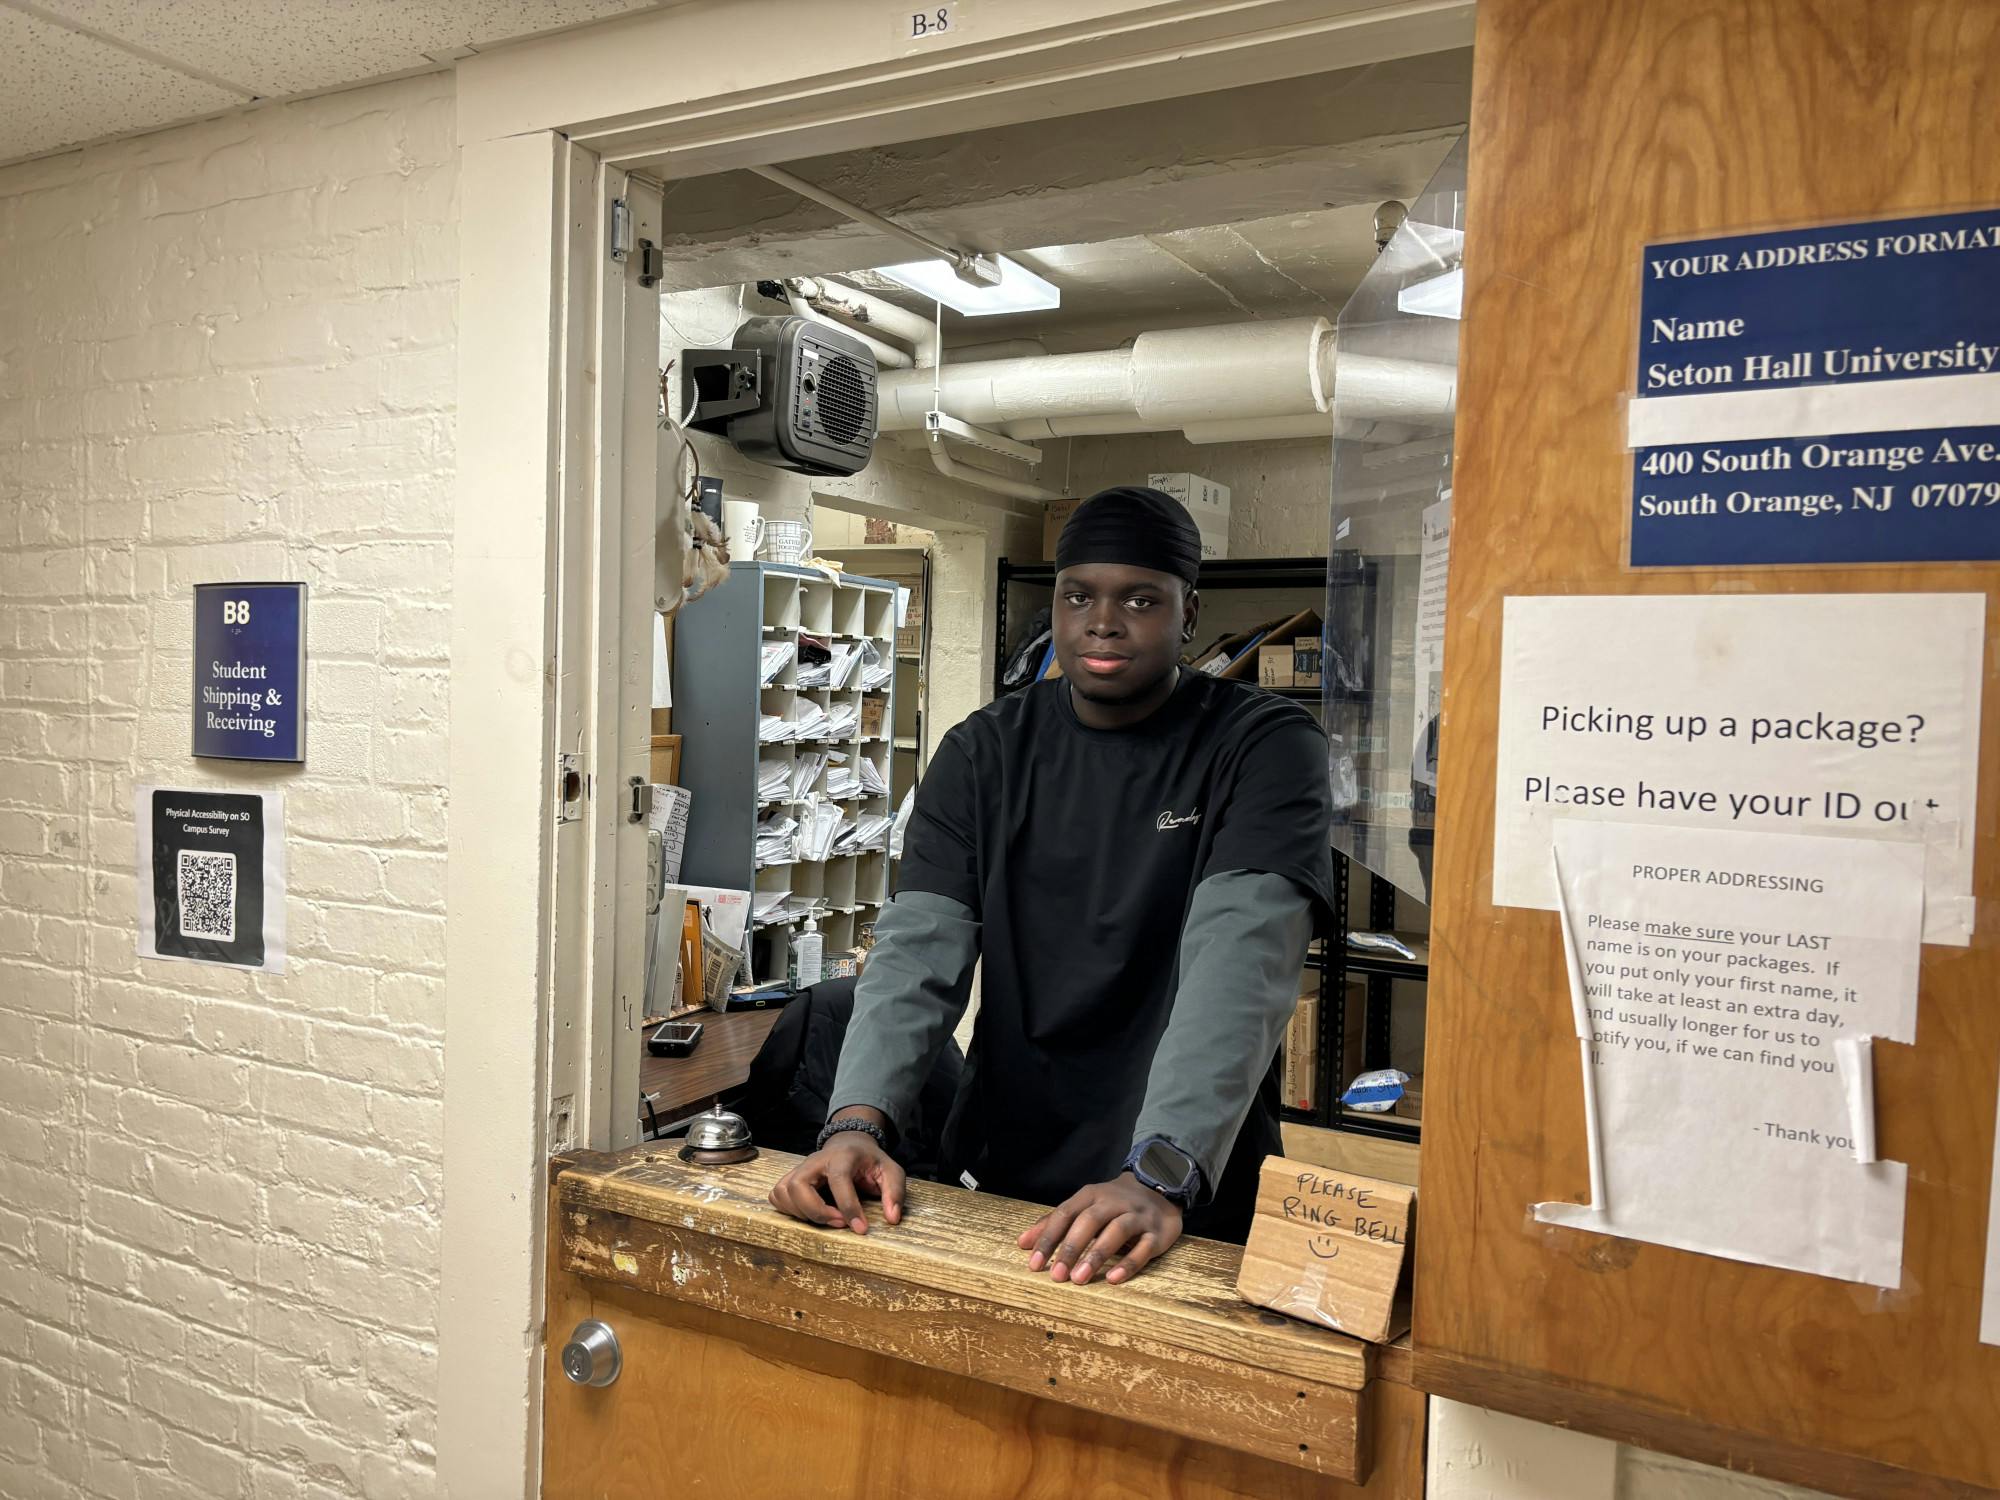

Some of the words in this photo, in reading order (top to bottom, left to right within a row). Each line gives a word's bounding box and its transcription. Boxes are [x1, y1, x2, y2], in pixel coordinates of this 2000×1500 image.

[912, 8, 948, 36] B-8
[1651, 254, 1730, 279] YOUR
[1734, 239, 1869, 271] ADDRESS
[1651, 316, 1745, 344] Name
[1647, 362, 1733, 389] Seton
[1743, 353, 1812, 381] Hall
[1823, 340, 2000, 376] University
[1641, 450, 1694, 475] 400
[1701, 446, 1792, 474] South
[1802, 442, 1925, 472] Orange
[1931, 437, 2000, 464] Ave.
[1639, 493, 1718, 517] South
[1726, 490, 1844, 517] Orange,
[1851, 485, 1896, 511] NJ
[1912, 481, 2000, 508] 07079
[224, 600, 250, 625] B8
[212, 660, 267, 679] Student
[203, 686, 262, 711] Shipping
[265, 688, 282, 706] &
[206, 711, 276, 738] Receiving
[1542, 705, 1654, 741] Picking
[1666, 714, 1707, 743] up
[1719, 718, 1737, 737] a
[1751, 712, 1926, 749] package?
[166, 807, 190, 820] Physical
[191, 809, 229, 822] Accessibility
[230, 813, 239, 821] on
[240, 812, 250, 821] SO
[1637, 781, 1717, 813] have
[1729, 792, 1811, 820] your
[1825, 791, 1861, 820] ID
[183, 824, 208, 835] Campus
[209, 826, 230, 837] Survey
[1633, 865, 1701, 883] PROPER
[1705, 871, 1824, 893] ADDRESSING
[1588, 914, 1640, 933] Please
[1645, 921, 1692, 938] make
[1696, 927, 1735, 942] sure
[1739, 931, 1781, 948] your
[1787, 933, 1831, 951] LAST
[1587, 940, 1633, 955] name
[1638, 941, 1650, 956] is
[1655, 947, 1677, 960] on
[1682, 949, 1722, 967] your
[1726, 950, 1815, 975] packages.
[1827, 962, 1840, 976] If
[1585, 962, 1616, 978] you
[1620, 964, 1649, 981] put
[1653, 966, 1690, 987] only
[1694, 974, 1736, 991] your
[1739, 975, 1775, 994] first
[1780, 981, 1839, 1003] name,
[1844, 987, 1857, 1003] it
[1586, 983, 1612, 999] will
[1617, 986, 1653, 1003] take
[1657, 991, 1675, 1006] at
[1680, 991, 1721, 1011] least
[1726, 1000, 1747, 1015] an
[1753, 1002, 1800, 1021] extra
[1805, 1005, 1845, 1029] day,
[1618, 1010, 1678, 1032] usually
[1682, 1015, 1738, 1037] longer
[1743, 1022, 1770, 1040] for
[1774, 1030, 1795, 1043] us
[1800, 1033, 1820, 1047] to
[1593, 1030, 1631, 1049] otify
[1634, 1036, 1671, 1054] you,
[1676, 1039, 1688, 1054] if
[1692, 1044, 1719, 1058] we
[1723, 1048, 1755, 1063] can
[1759, 1050, 1796, 1068] find
[1800, 1058, 1835, 1075] you
[1764, 1122, 1820, 1145] Thank
[1297, 1173, 1377, 1208] PLEASE
[1283, 1196, 1341, 1227] RING
[1355, 1217, 1405, 1245] BELL
